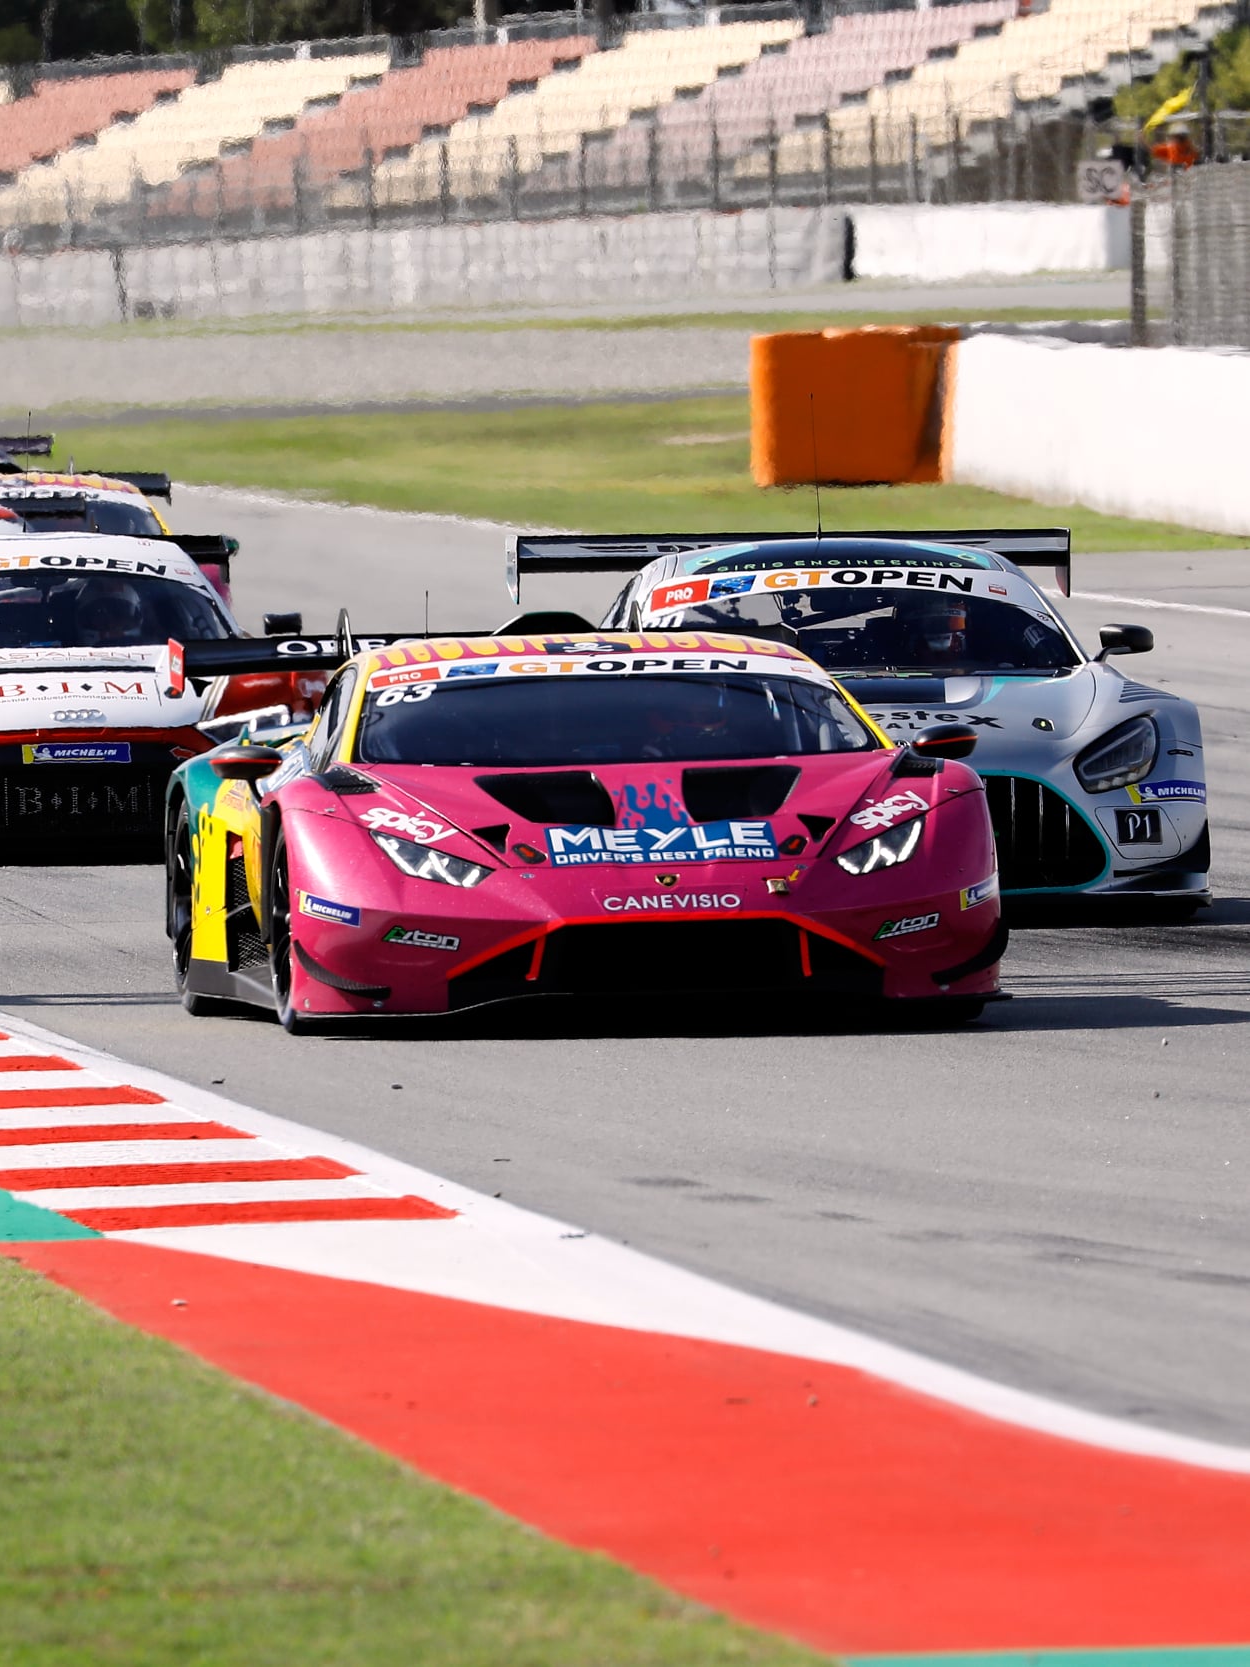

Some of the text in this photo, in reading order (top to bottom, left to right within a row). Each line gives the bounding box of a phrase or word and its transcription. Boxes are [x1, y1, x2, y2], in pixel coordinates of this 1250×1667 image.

[793, 558, 964, 570] ENGINEERING
[665, 586, 694, 604] PRO
[388, 671, 422, 685] PRO
[375, 683, 437, 707] 63
[54, 748, 117, 757] MICHELIN
[1157, 786, 1206, 796] MICHELIN
[850, 791, 930, 830] spicy
[359, 807, 459, 844] spicy
[1125, 812, 1151, 840] P1
[549, 822, 771, 852] MEYLE
[555, 847, 775, 865] DRIVER'S BEST FRIEND
[311, 901, 353, 920] MICHELIN
[603, 893, 741, 911] CANEVISIO
